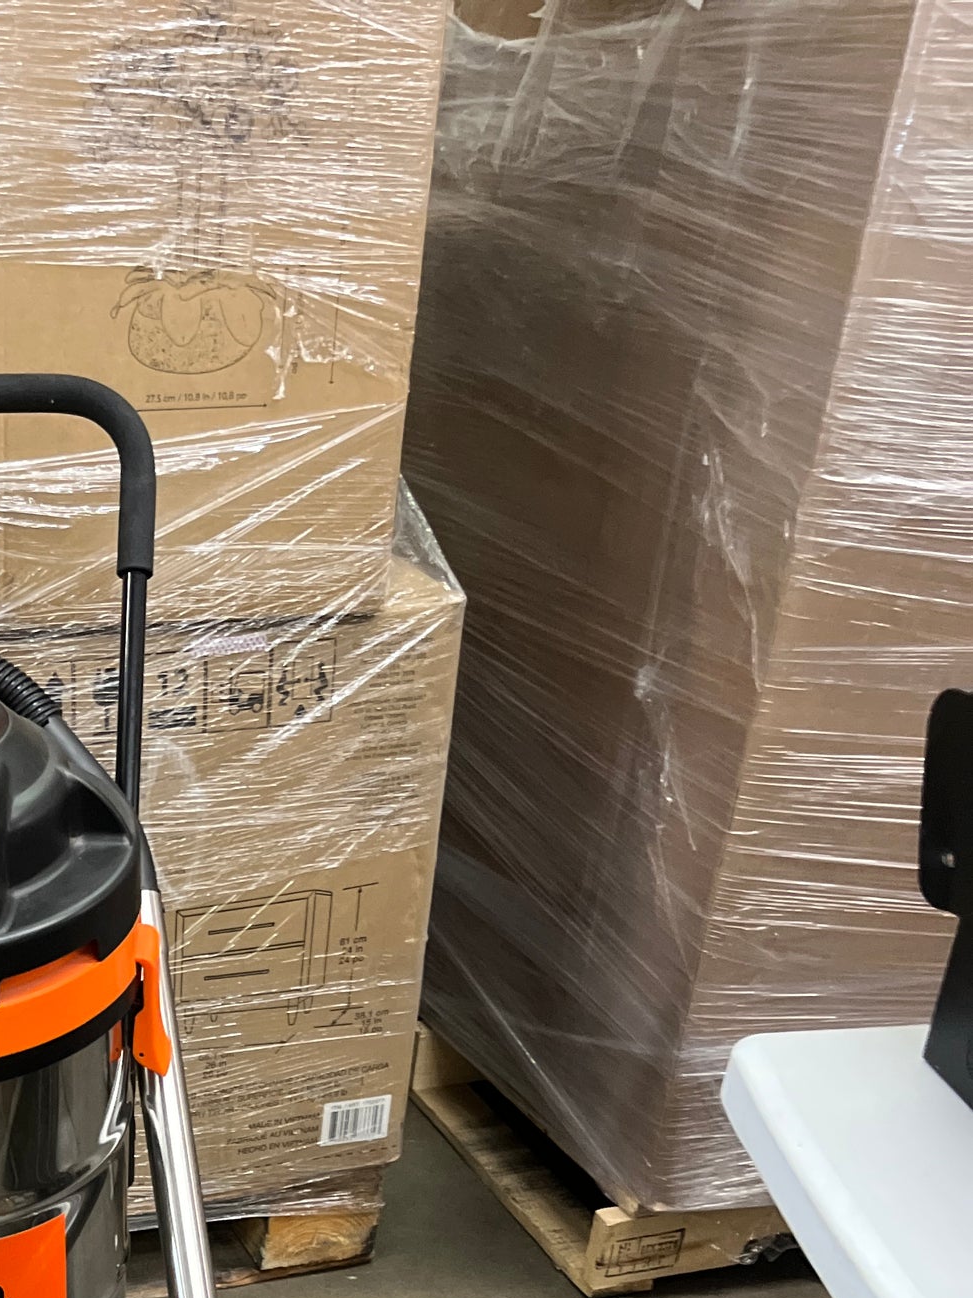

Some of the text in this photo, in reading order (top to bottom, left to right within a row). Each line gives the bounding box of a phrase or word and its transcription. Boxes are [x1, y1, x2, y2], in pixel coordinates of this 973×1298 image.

[163, 395, 176, 403] cm
[353, 936, 368, 944] cm
[355, 945, 364, 953] in
[376, 1009, 390, 1017] cm
[269, 1141, 280, 1151] EN
